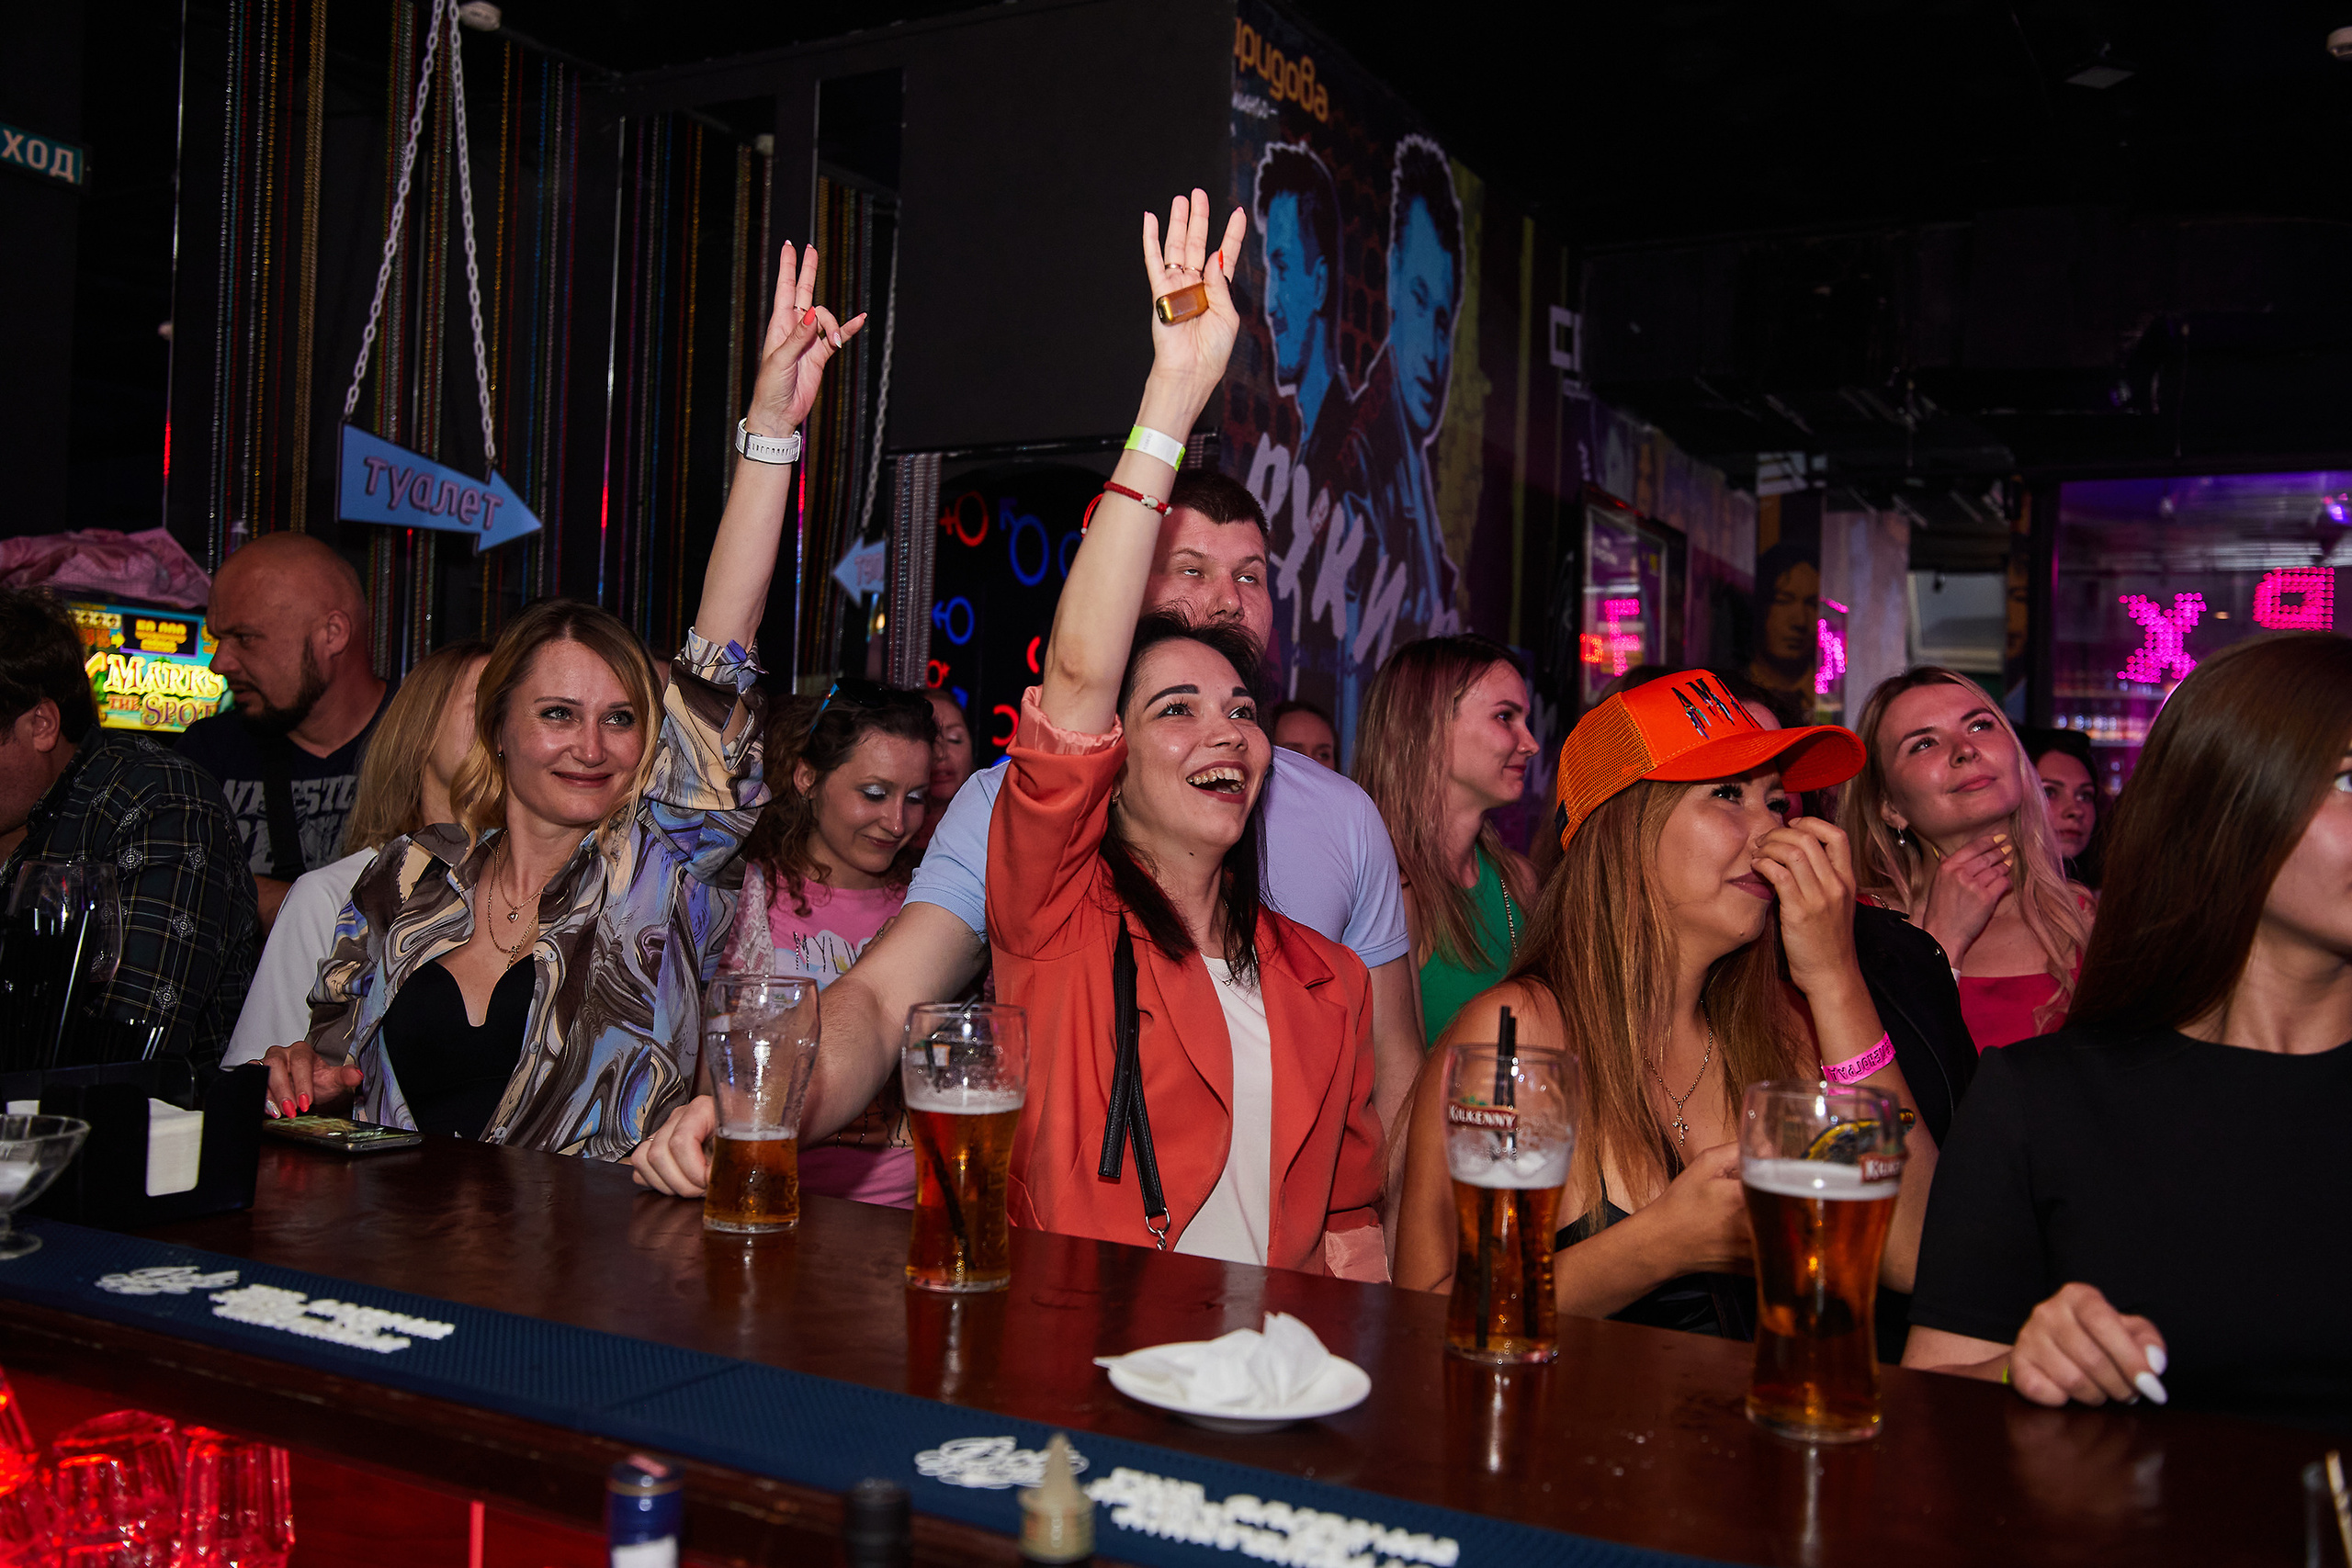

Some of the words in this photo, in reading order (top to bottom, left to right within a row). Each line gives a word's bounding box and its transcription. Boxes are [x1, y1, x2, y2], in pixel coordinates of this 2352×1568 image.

[364, 456, 504, 530] туалет
[103, 653, 223, 699] MARKS
[107, 694, 141, 712] THE
[1827, 1038, 1894, 1083] ЕЛЕНОГРАД
[1449, 1104, 1516, 1129] KILKENNY
